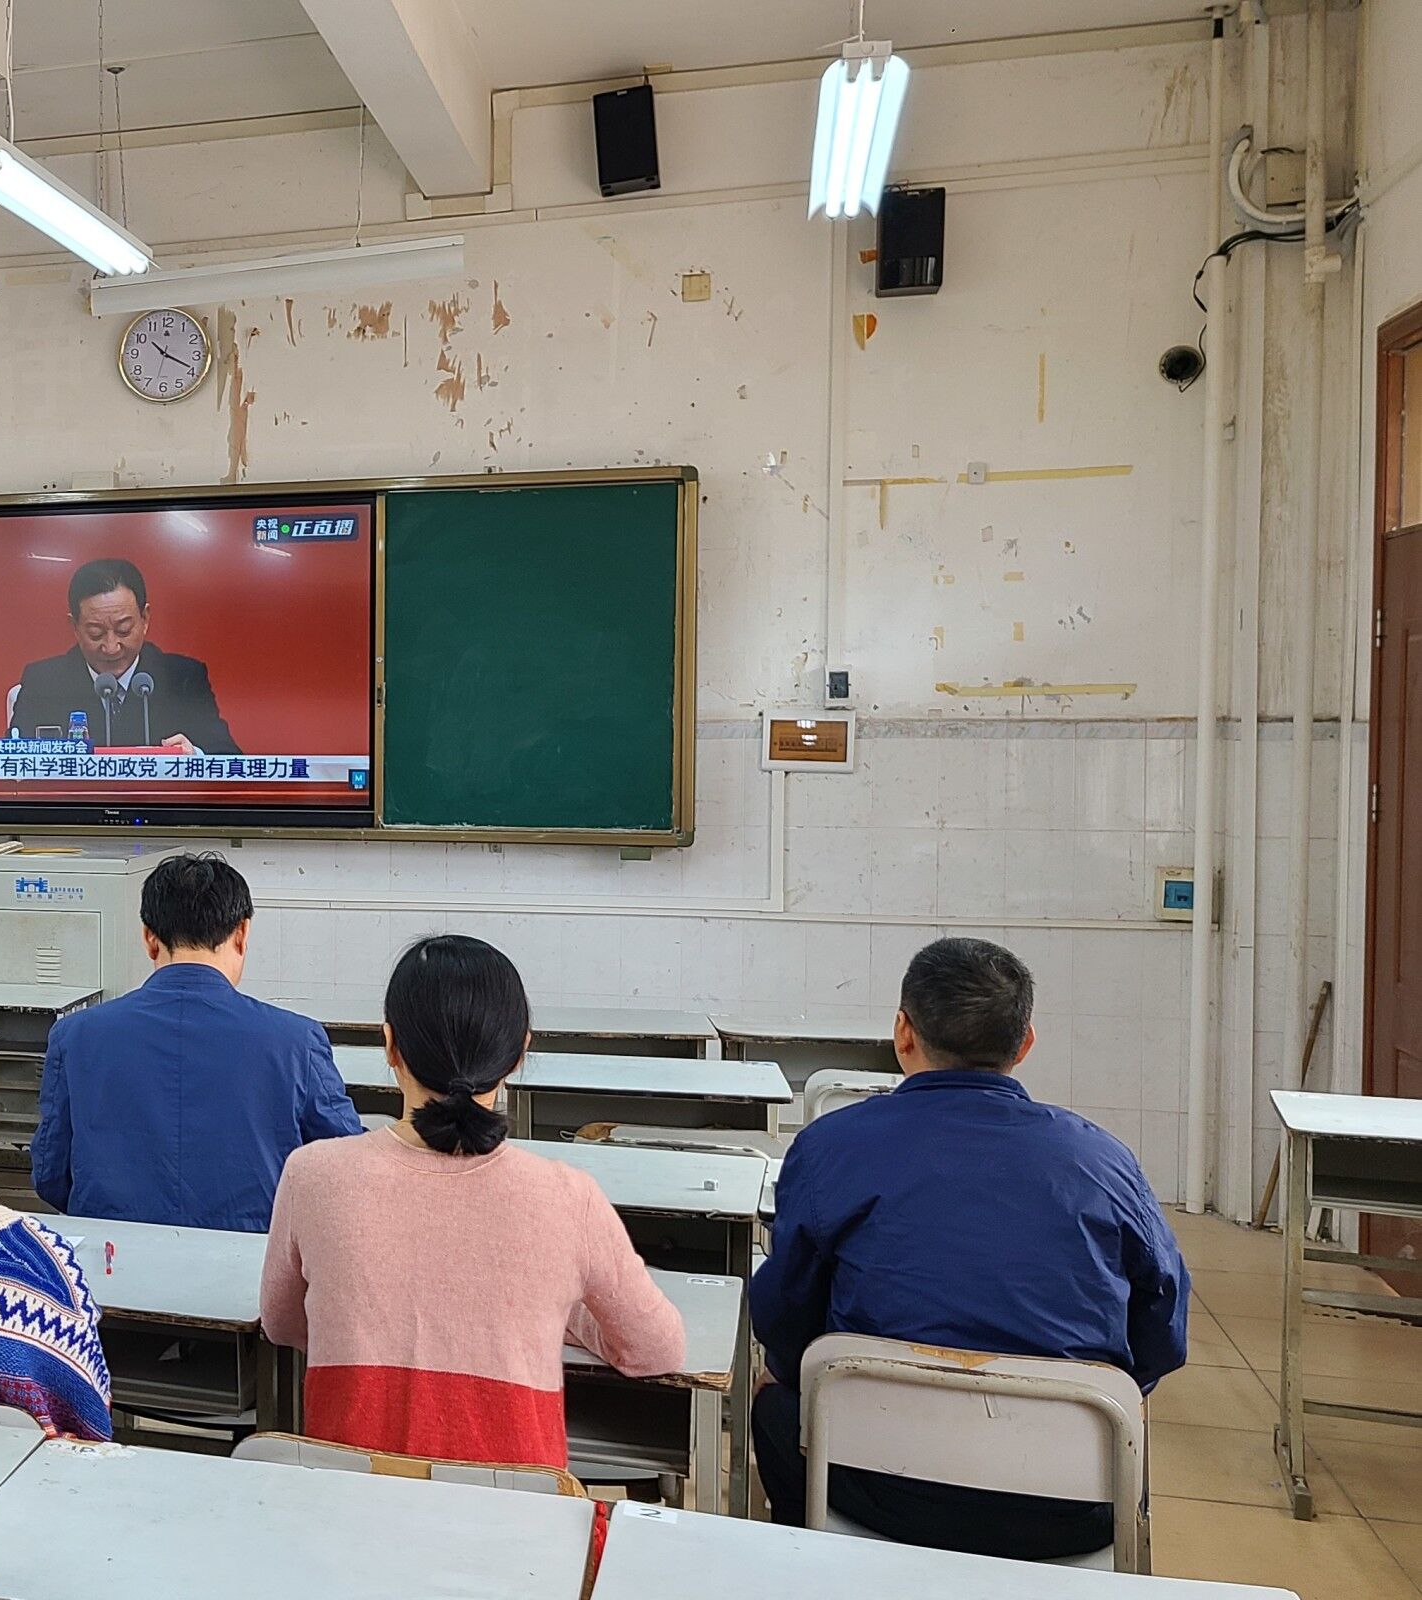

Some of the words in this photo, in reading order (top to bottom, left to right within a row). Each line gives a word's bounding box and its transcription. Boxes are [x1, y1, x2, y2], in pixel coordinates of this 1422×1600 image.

[148, 322, 157, 332] 11
[162, 317, 174, 328] 12
[181, 322, 186, 332] 1
[136, 333, 147, 344] 10
[189, 334, 198, 345] 2
[130, 349, 139, 359] 9
[192, 351, 201, 361] 3
[133, 365, 142, 375] 8
[187, 367, 195, 378] 4
[144, 377, 152, 387] 7
[159, 382, 168, 393] 6
[175, 378, 183, 389] 5
[256, 518, 278, 530] 央视
[291, 519, 355, 537] 正直播
[256, 530, 278, 541] 新闻
[164, 757, 310, 780] 才拥有真理力量
[640, 1508, 662, 1519] 2
